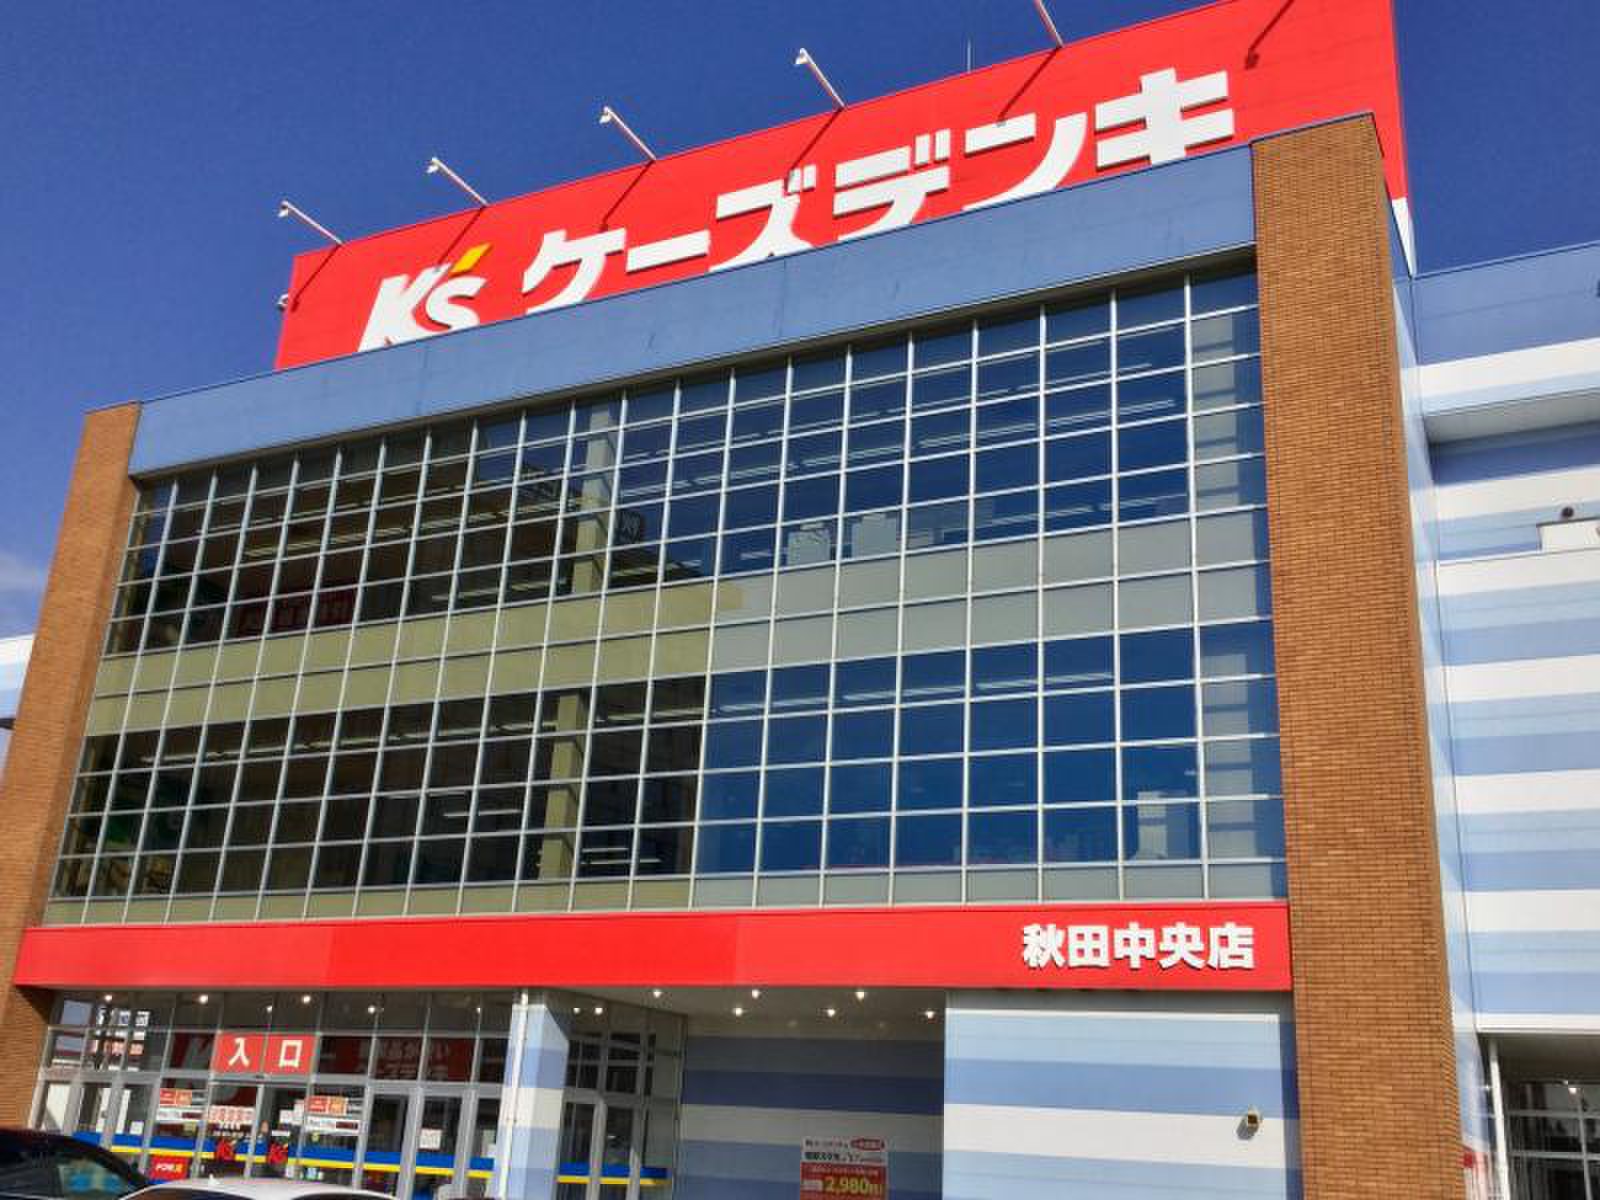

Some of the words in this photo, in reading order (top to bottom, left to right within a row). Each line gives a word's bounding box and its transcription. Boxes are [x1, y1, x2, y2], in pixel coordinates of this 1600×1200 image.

[358, 243, 492, 351] K's
[522, 68, 1235, 313] ケーズデンキ
[1022, 922, 1254, 969] 秋田中央店
[228, 1037, 303, 1068] 入口
